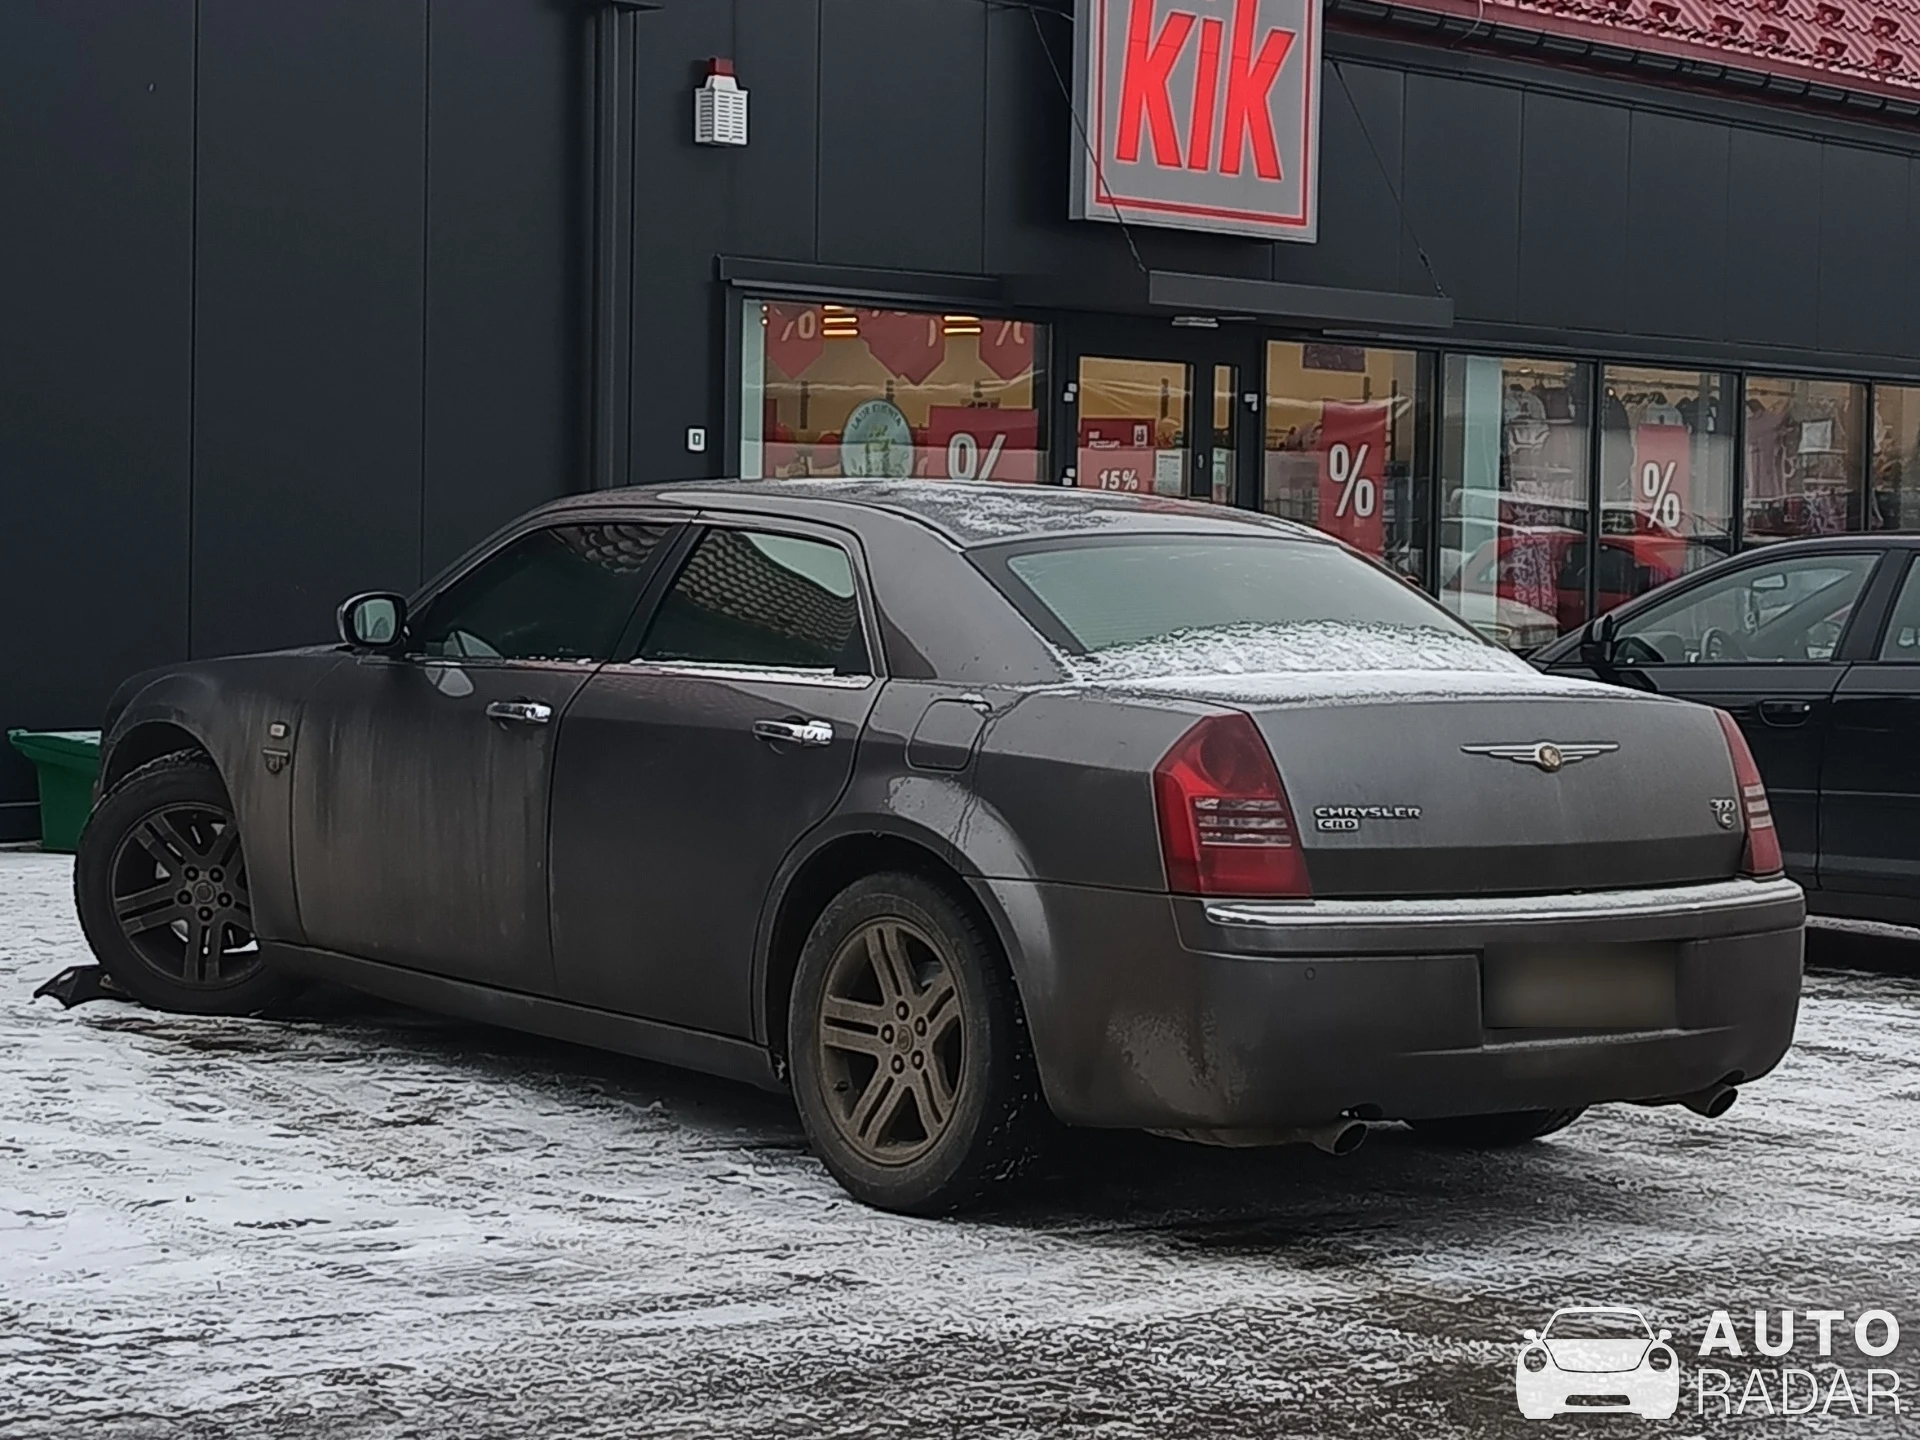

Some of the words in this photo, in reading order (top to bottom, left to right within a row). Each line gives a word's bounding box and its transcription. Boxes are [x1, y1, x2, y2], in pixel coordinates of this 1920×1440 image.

[1099, 468, 1138, 490] 15%
[1329, 443, 1375, 517] %
[1643, 461, 1681, 528] %
[1314, 807, 1421, 817] CHRYSLER
[1320, 820, 1356, 829] CRD
